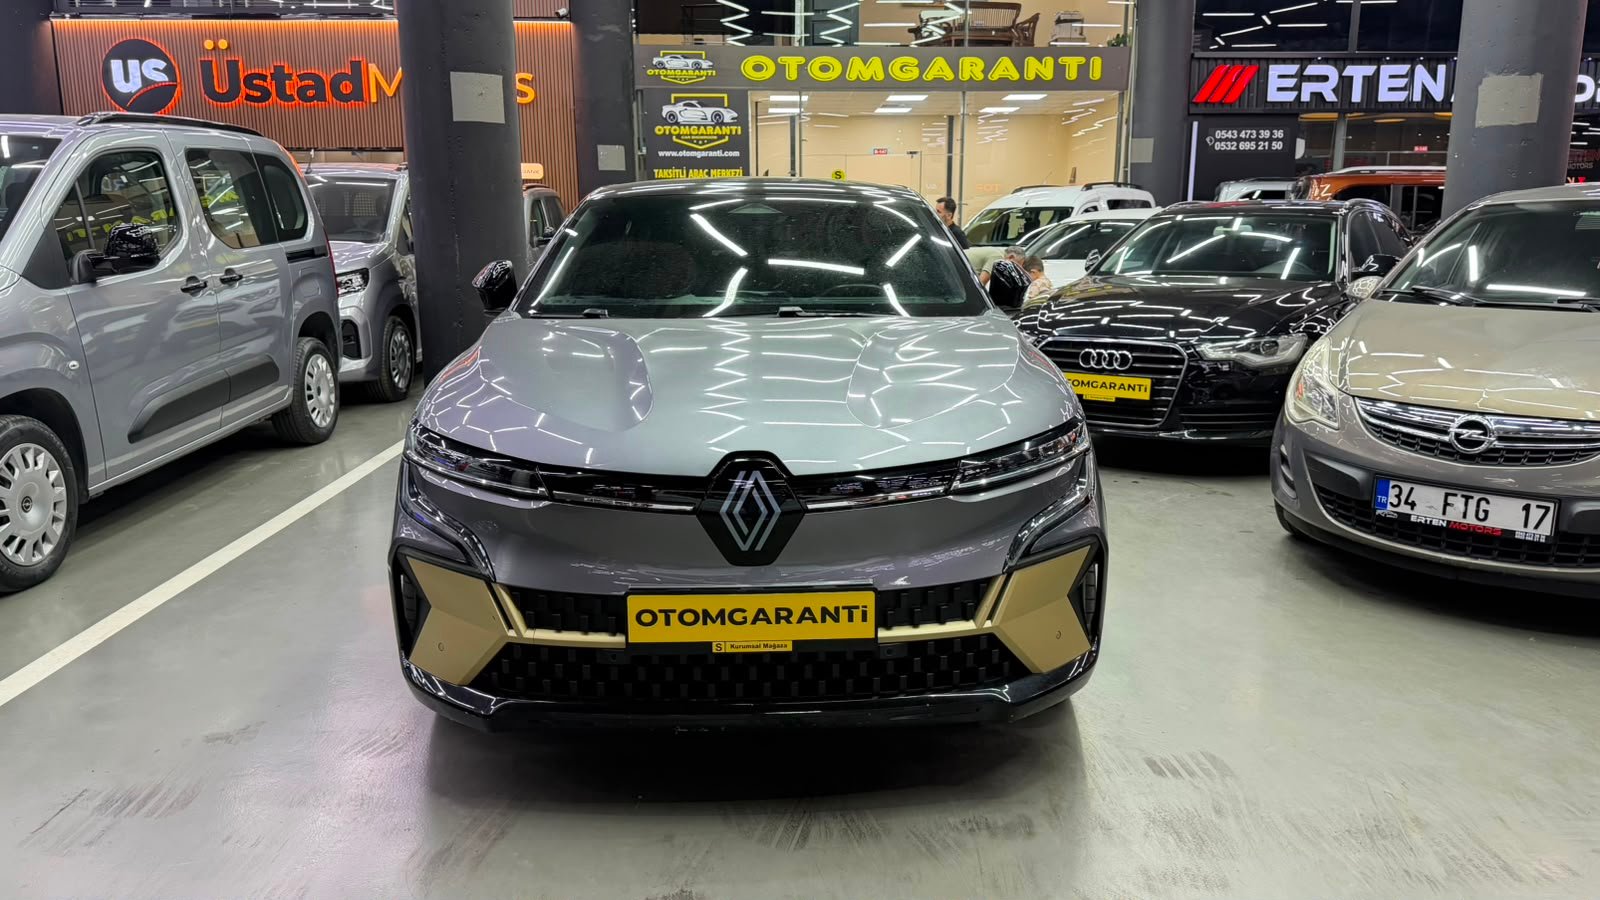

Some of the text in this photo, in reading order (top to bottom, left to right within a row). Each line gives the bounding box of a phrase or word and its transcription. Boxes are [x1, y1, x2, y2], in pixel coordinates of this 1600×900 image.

[741, 55, 1103, 82] OTOMGARANTI
[1266, 64, 1447, 103] ERTEN
[654, 125, 742, 135] OTOMGARANTI
[1215, 129, 1284, 139] 0543 473 39 36
[1214, 141, 1283, 151] 0532 695 21 50
[657, 149, 740, 159] www.otomgaranti.com
[1377, 495, 1387, 505] TR
[1389, 484, 1551, 530] 34 FTG 17
[1410, 514, 1447, 528] ERTEN
[1448, 521, 1503, 537] MOTORS
[762, 642, 788, 651] Mağaza
